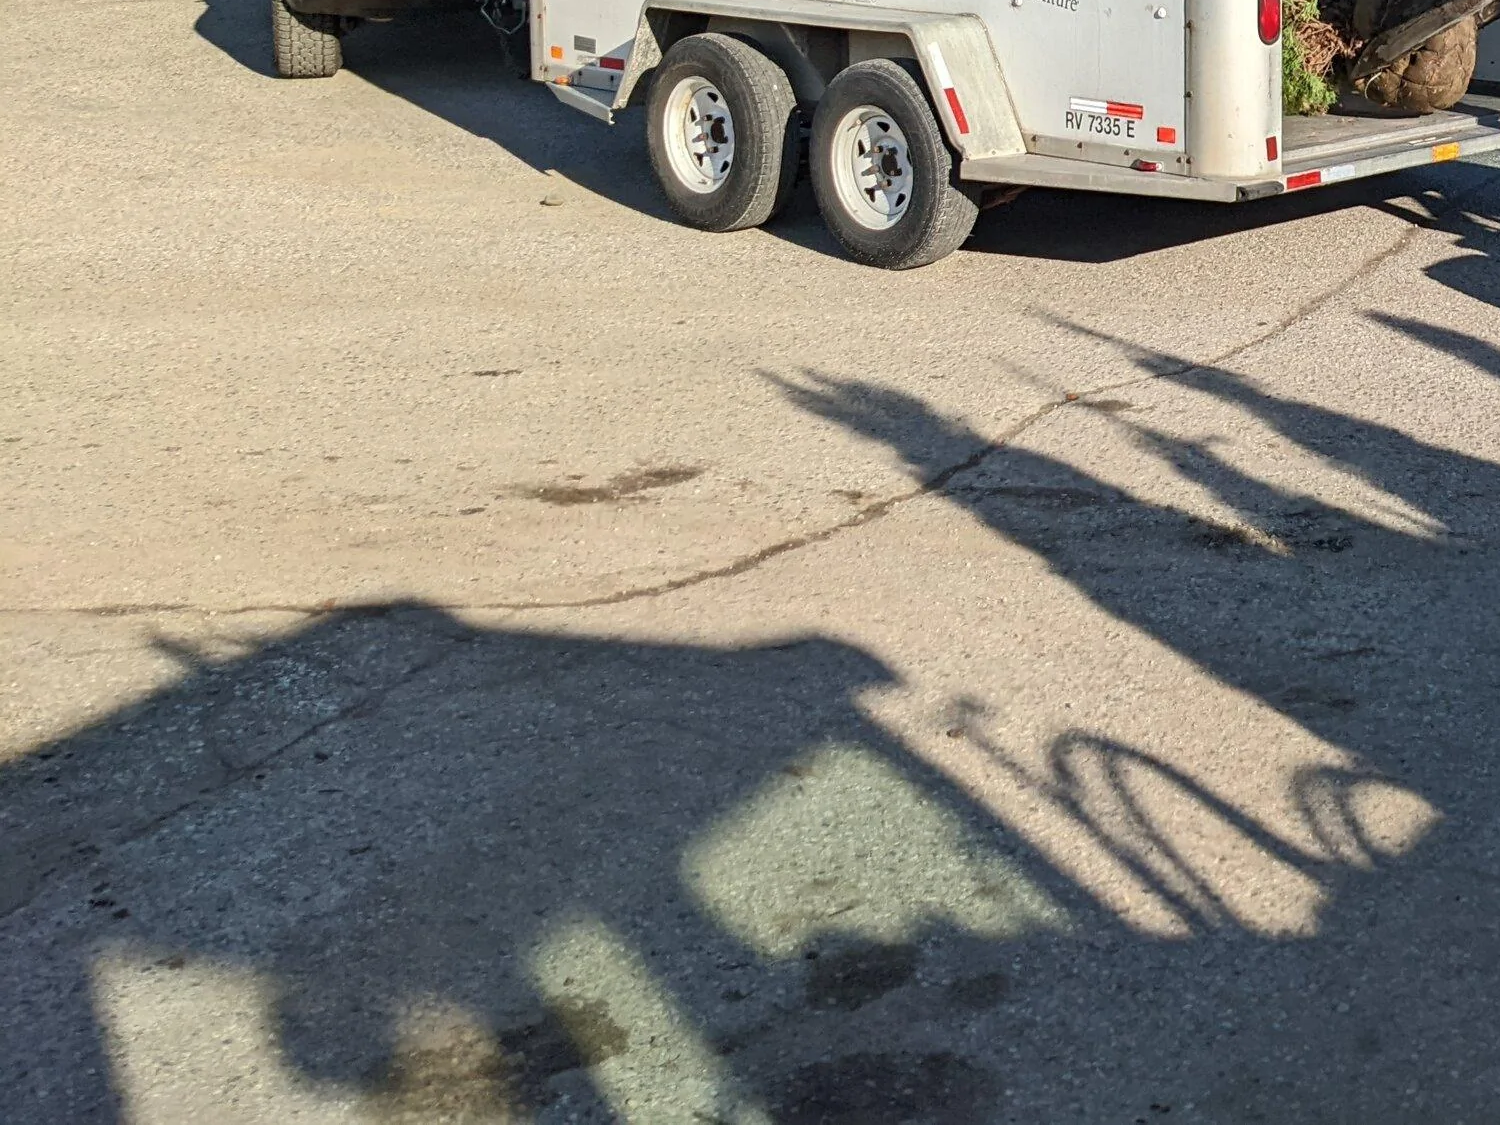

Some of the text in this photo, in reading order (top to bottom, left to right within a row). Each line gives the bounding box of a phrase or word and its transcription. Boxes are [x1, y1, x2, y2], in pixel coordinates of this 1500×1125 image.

[1065, 111, 1135, 138] RV 7335 E
